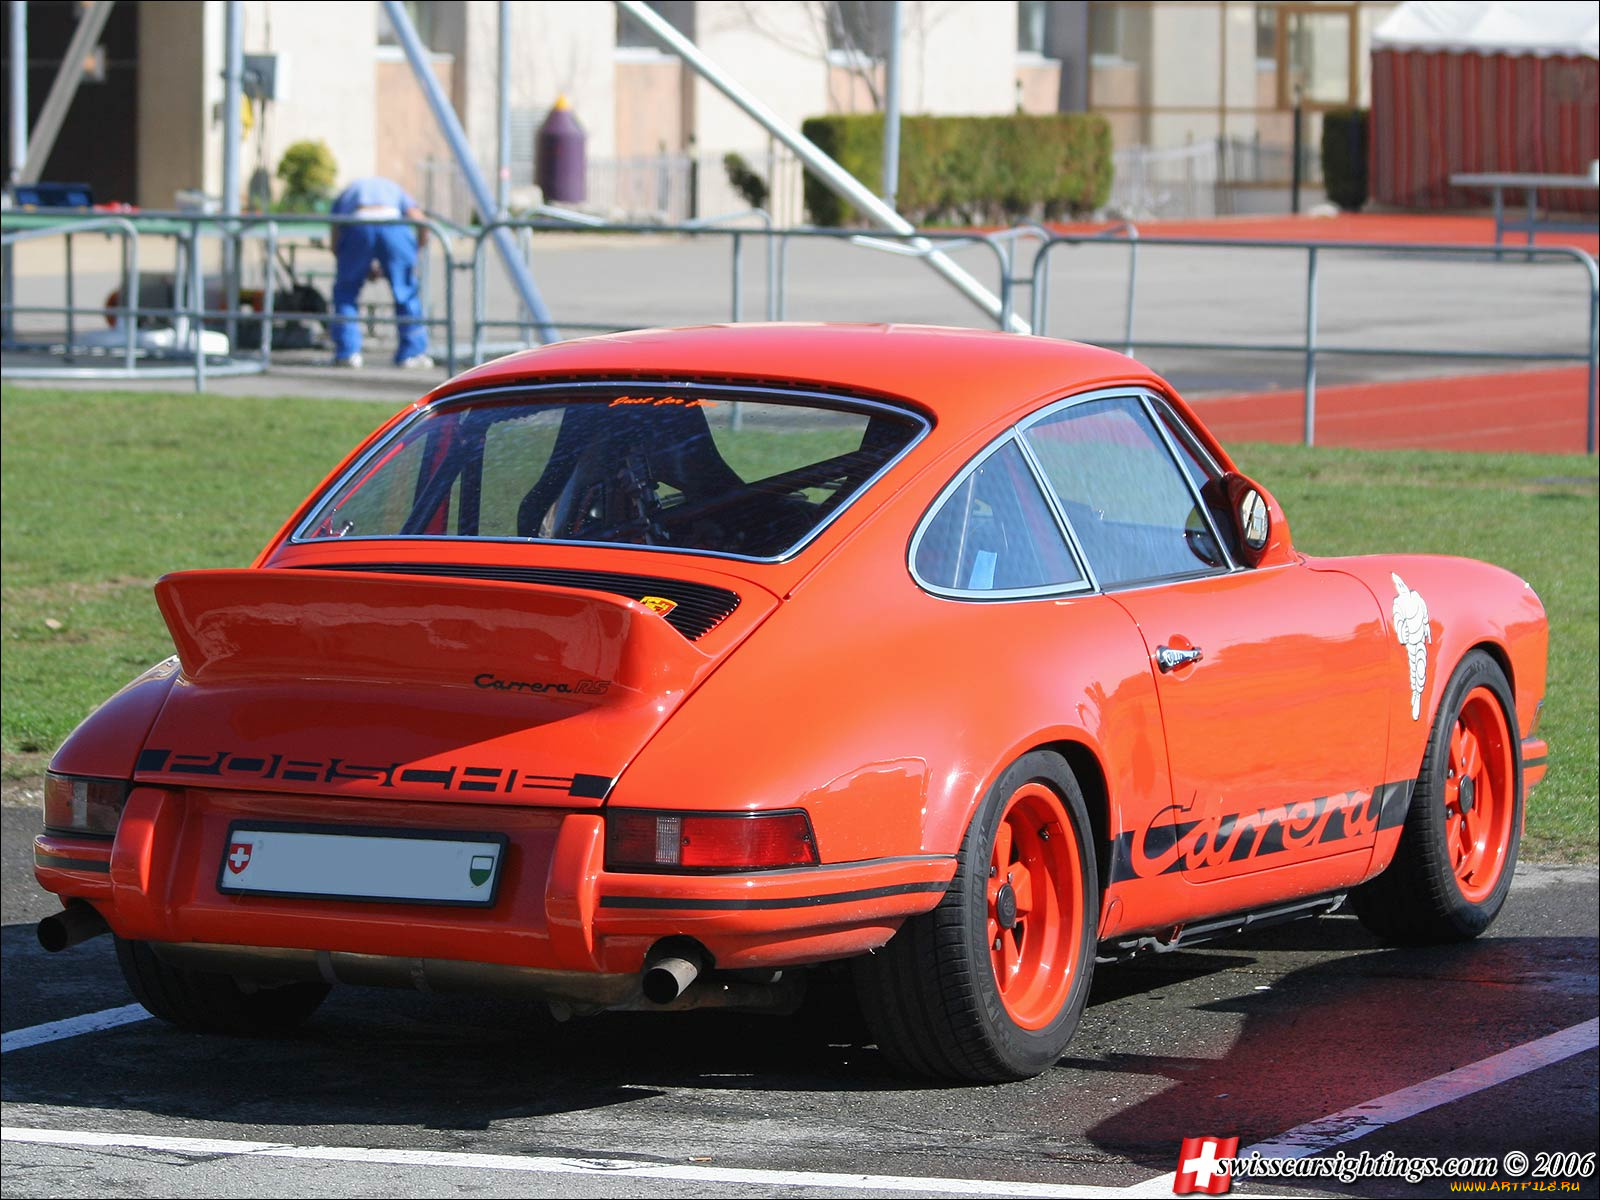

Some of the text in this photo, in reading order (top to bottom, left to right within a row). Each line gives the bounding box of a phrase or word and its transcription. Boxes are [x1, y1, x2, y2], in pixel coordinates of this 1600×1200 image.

[608, 396, 654, 408] Just
[653, 396, 685, 407] for
[473, 673, 612, 696] Carrera RS
[166, 751, 576, 796] PORSCHE
[1130, 788, 1379, 879] Carrera
